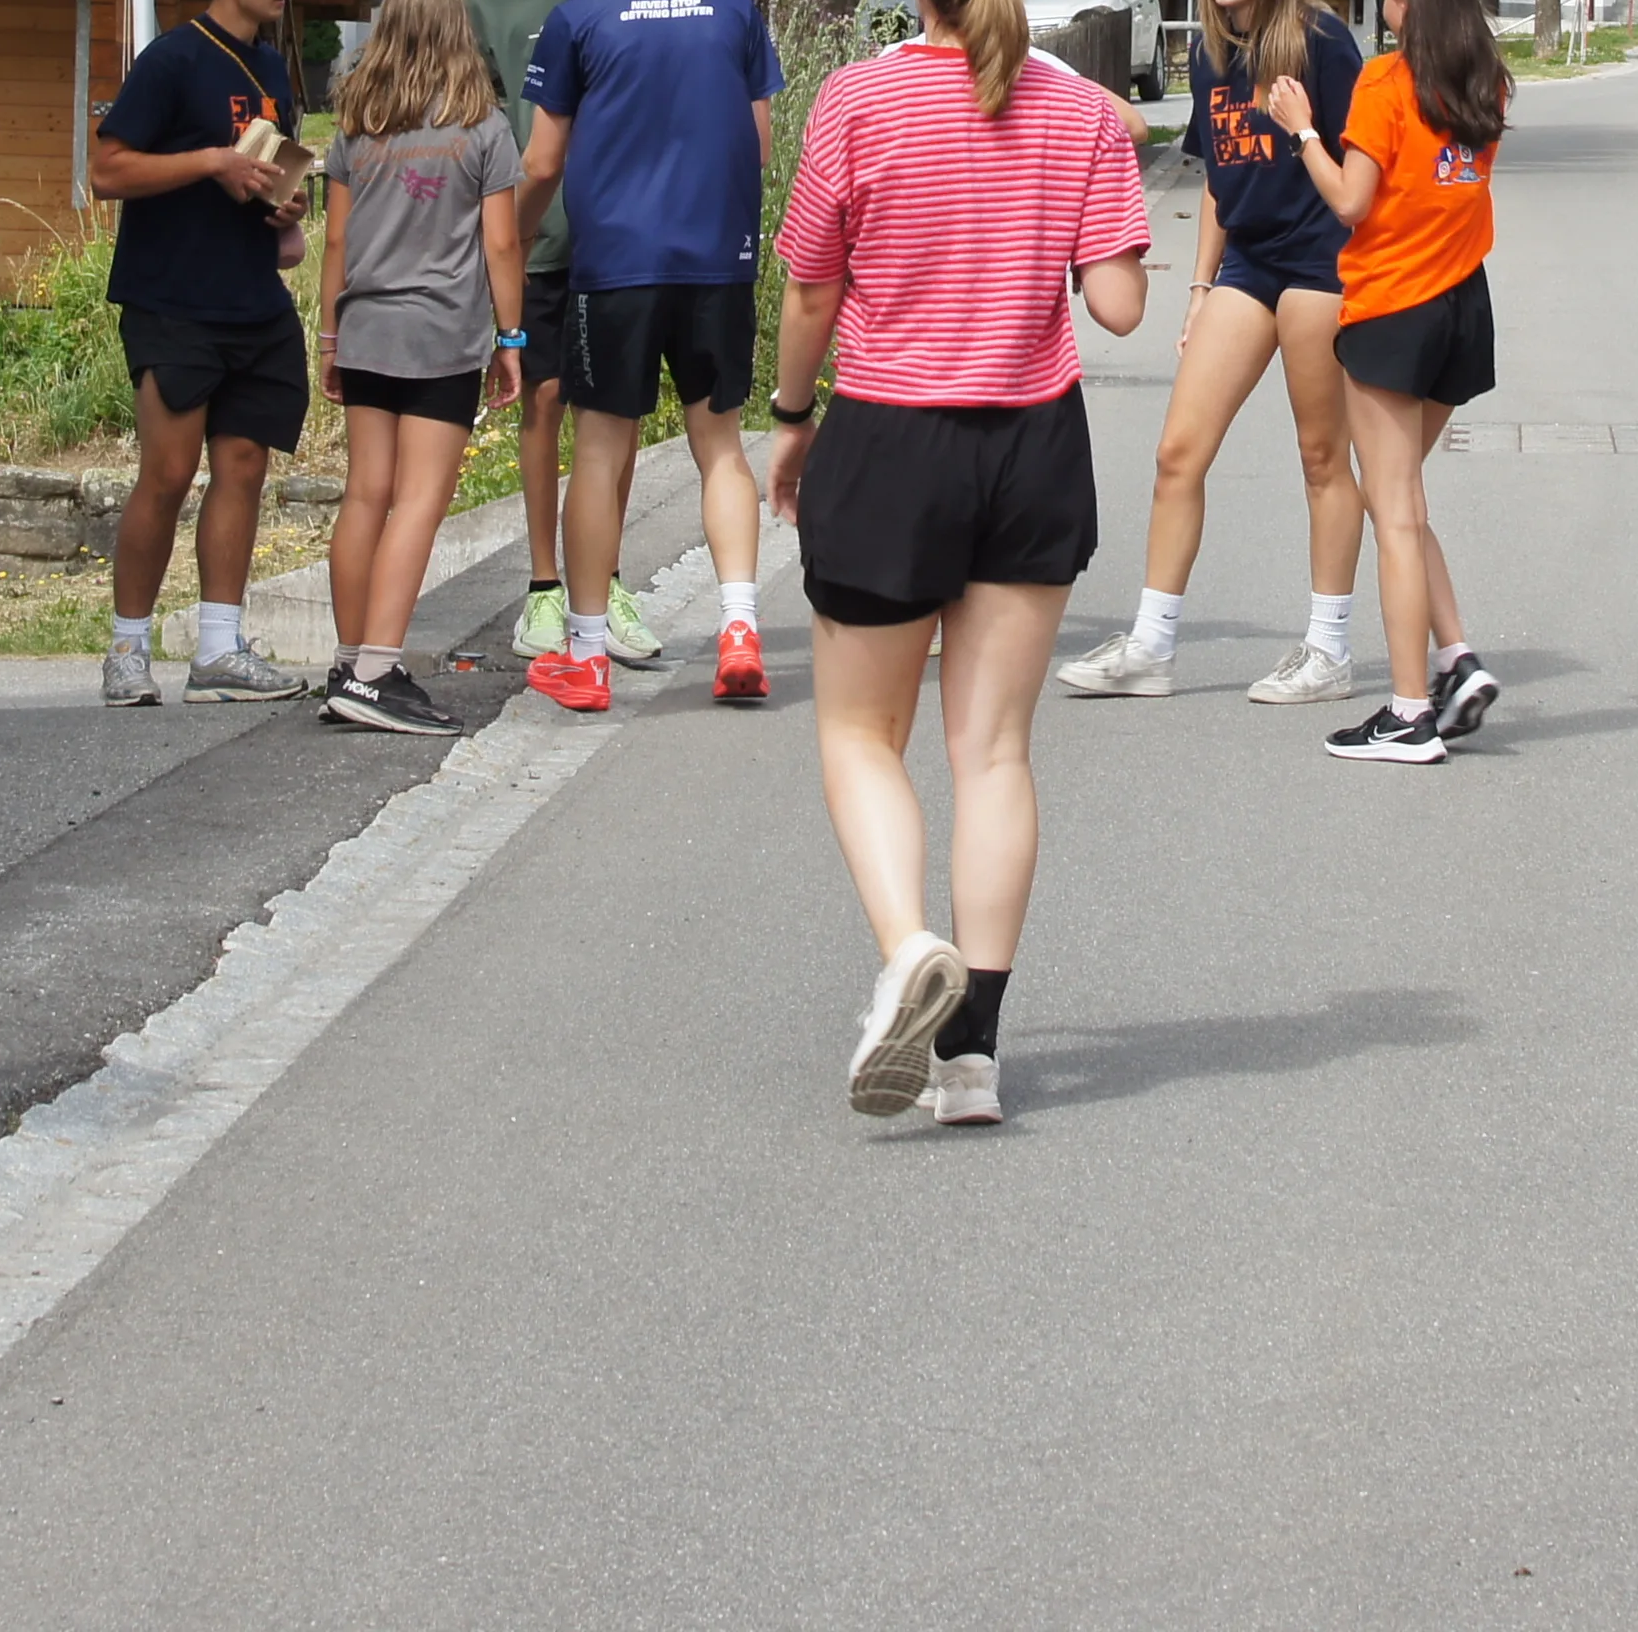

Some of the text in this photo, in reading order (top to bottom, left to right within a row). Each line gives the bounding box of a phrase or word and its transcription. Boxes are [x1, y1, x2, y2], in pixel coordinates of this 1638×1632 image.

[630, 0, 669, 10] NEVER
[620, 6, 714, 21] GETTING BETTER
[342, 678, 380, 702] HOKA
